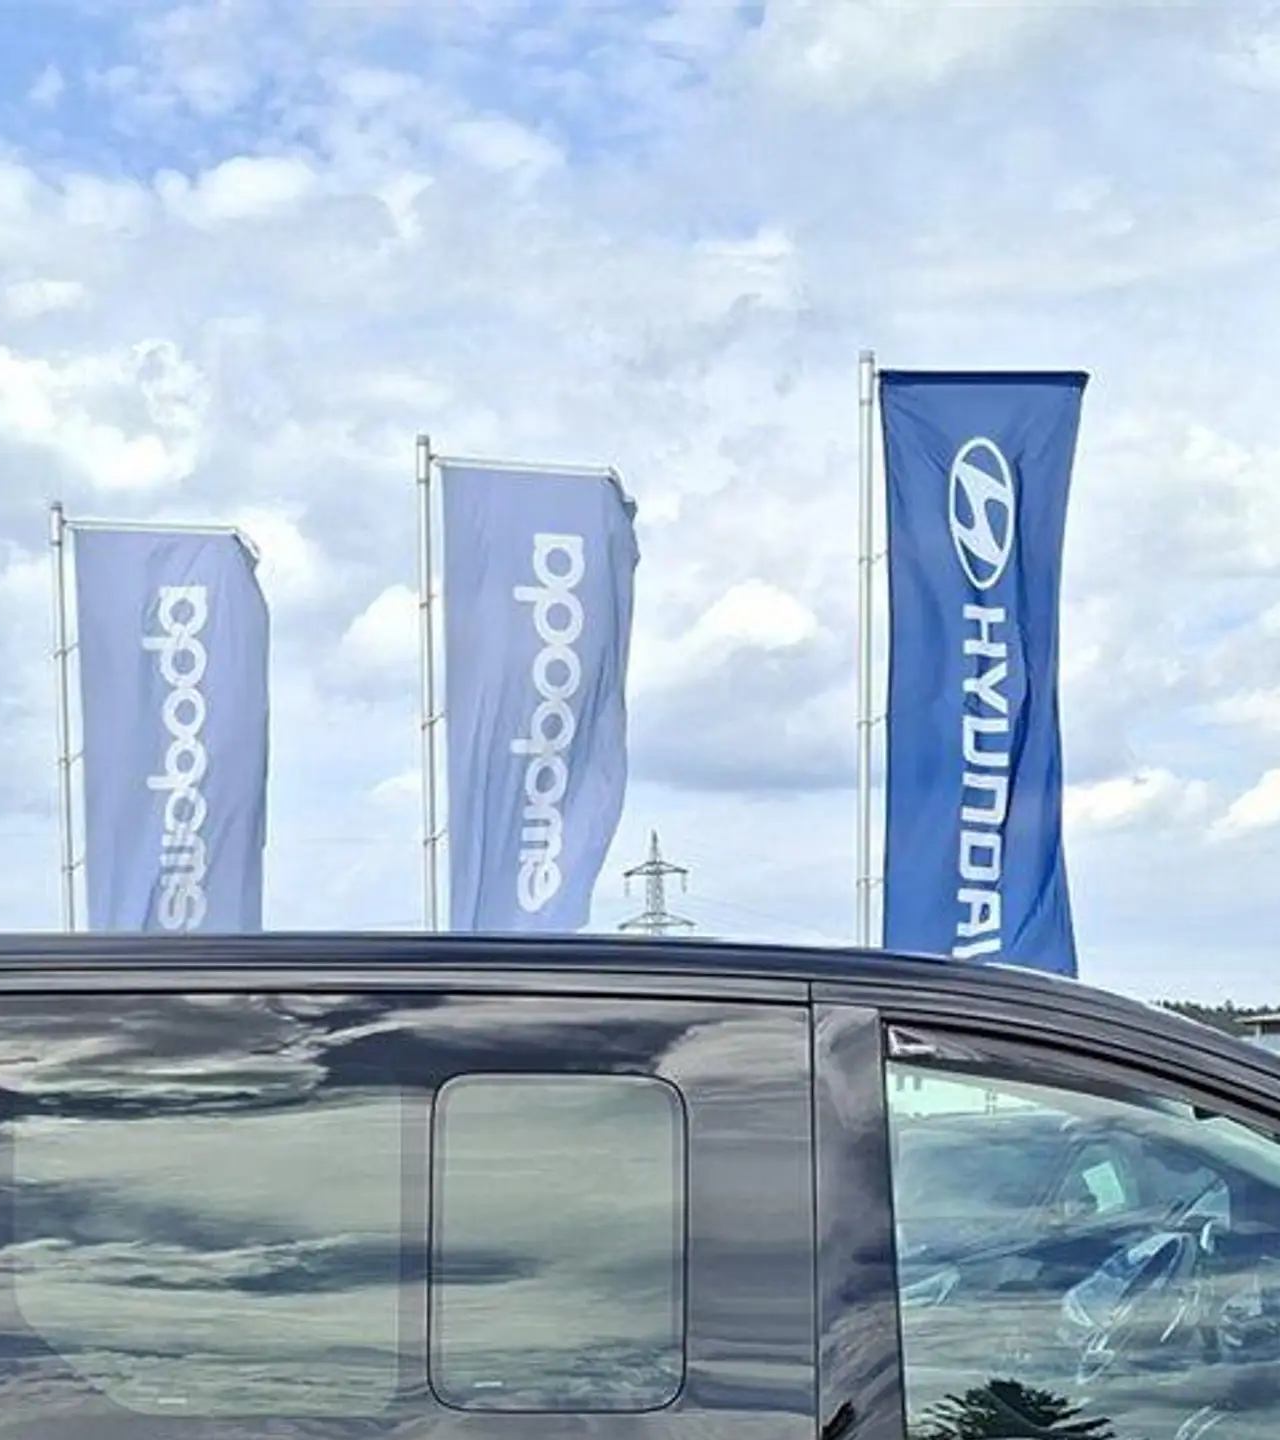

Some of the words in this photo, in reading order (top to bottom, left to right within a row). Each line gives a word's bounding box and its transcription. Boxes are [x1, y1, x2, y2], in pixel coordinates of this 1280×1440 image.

[142, 585, 208, 931] swoboda
[510, 533, 585, 913] swoboda
[952, 604, 1010, 959] HYUNDAI
